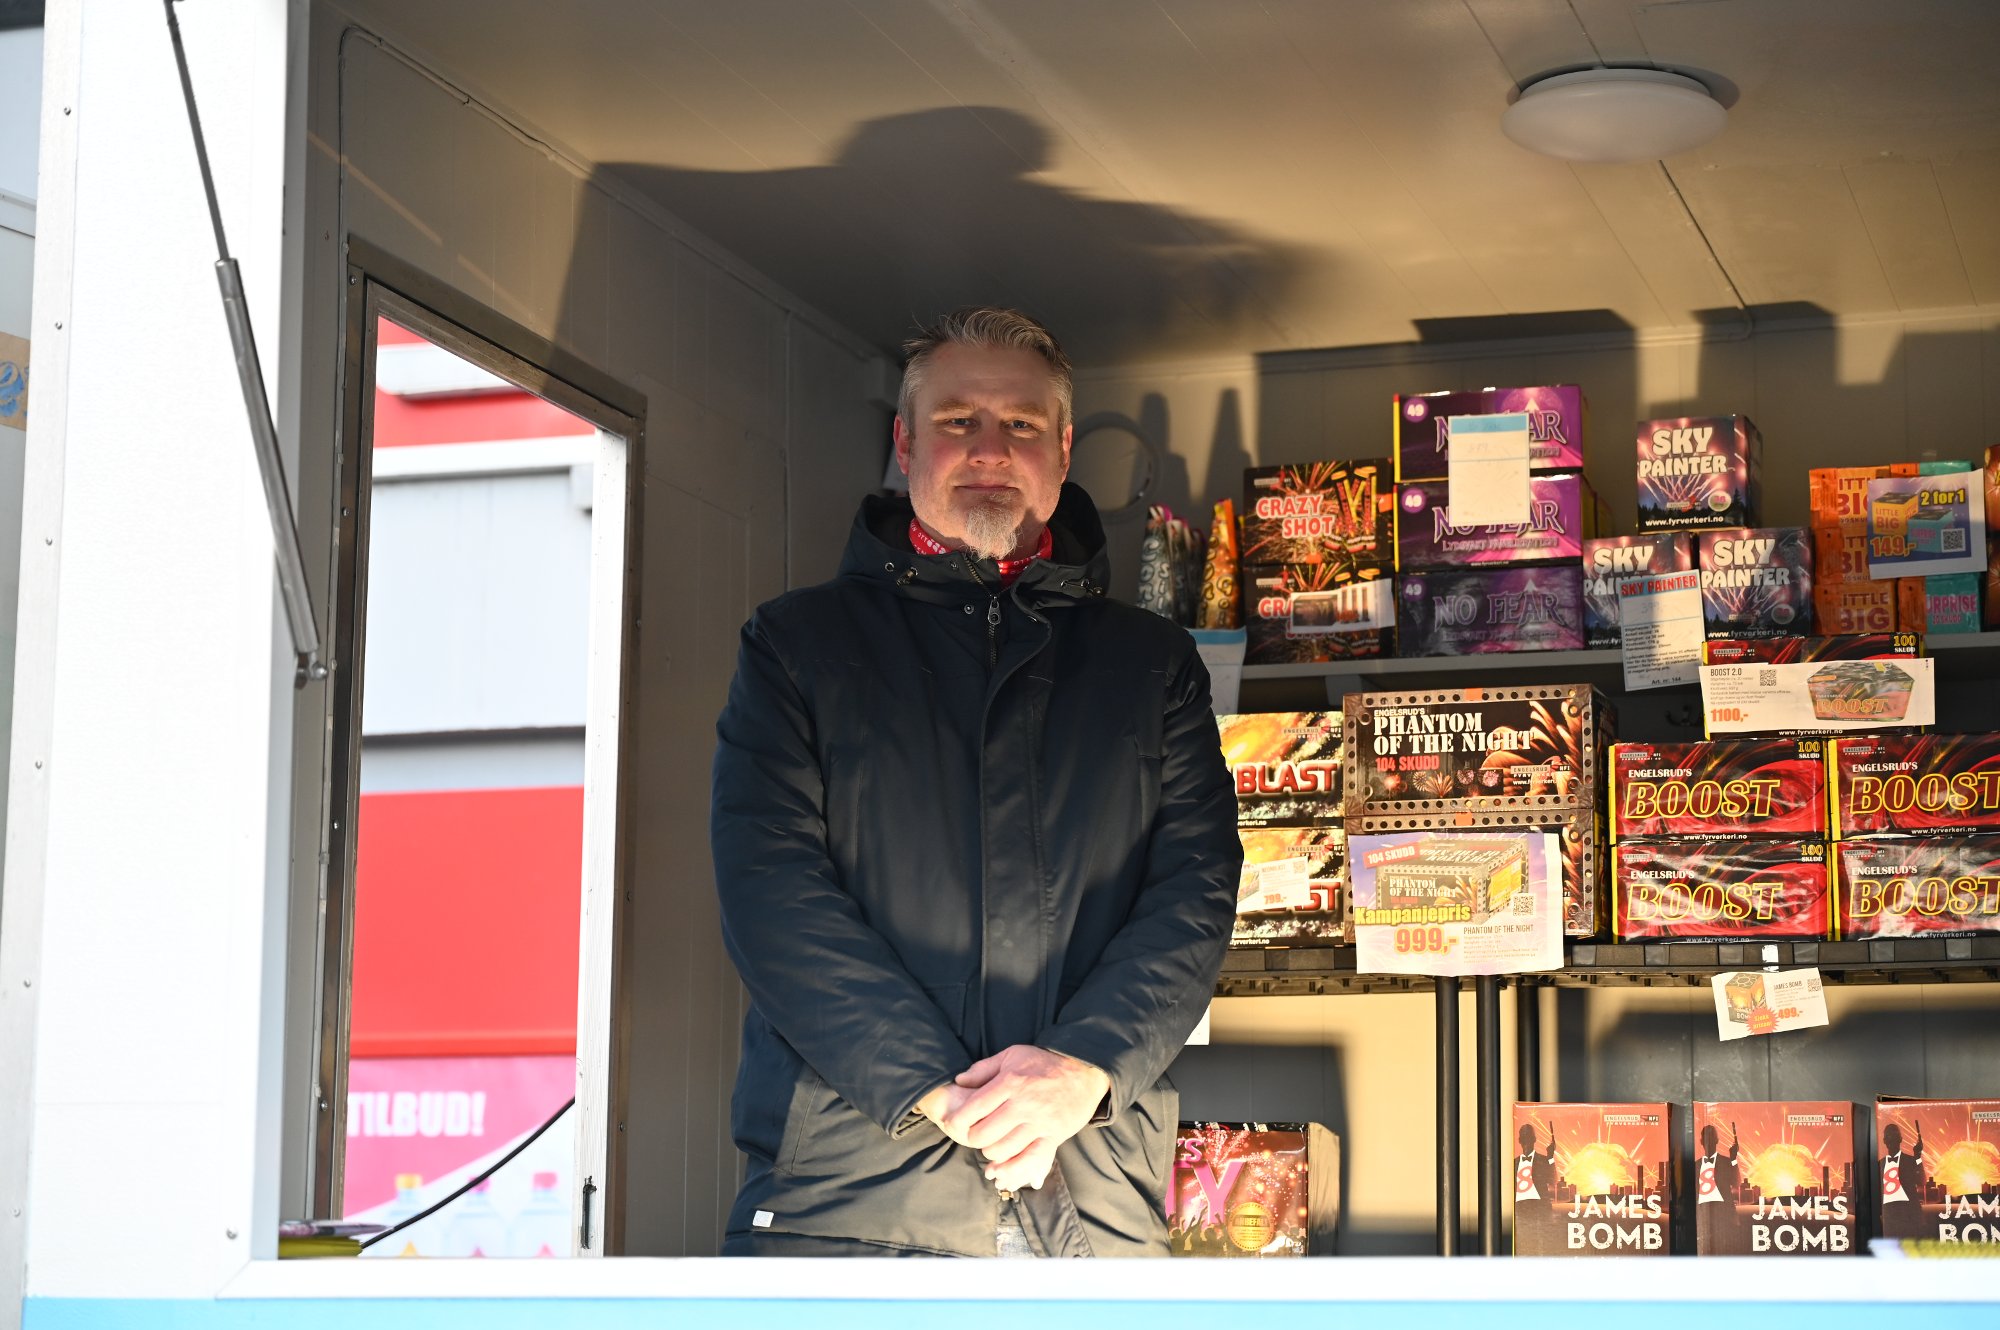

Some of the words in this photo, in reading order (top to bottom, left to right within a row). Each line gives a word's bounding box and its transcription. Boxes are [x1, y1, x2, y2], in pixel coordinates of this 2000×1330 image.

[1407, 404, 1424, 417] 49
[1652, 427, 1713, 456] SKY
[1639, 455, 1727, 478] PAINTER
[1256, 494, 1324, 519] CRAZY
[1405, 495, 1422, 508] 49
[1920, 492, 1929, 506] 2
[1933, 491, 1954, 504] for
[1957, 489, 1965, 503] 1
[1645, 515, 1724, 527] www.fyrverkeri.no
[1875, 507, 1899, 517] LITTLE
[1282, 515, 1336, 539] SHOT
[1876, 517, 1900, 530] BIG
[1713, 538, 1775, 567] SKY
[1871, 536, 1916, 557] 149,-
[1593, 545, 1654, 575] SKY
[1621, 581, 1645, 597] SKY
[1647, 575, 1697, 593] PAINTER
[1701, 567, 1791, 588] PAINTER
[1405, 583, 1422, 596] 49
[1258, 597, 1292, 619] CRA
[1842, 592, 1889, 607] ITTLE
[1432, 594, 1478, 632] NO
[1486, 590, 1568, 629] FEAR
[1708, 629, 1788, 639] www.fyrverkeri.no
[1893, 634, 1917, 647] 100
[1710, 668, 1730, 676] BOOST
[1731, 667, 1742, 676] 2.0
[1374, 707, 1426, 717] ENGELSRUD'S
[1711, 707, 1749, 722] 1100,-
[1815, 698, 1889, 713] BOOST
[1374, 712, 1483, 736] PHANTOM
[1374, 735, 1403, 756] OF
[1409, 733, 1455, 754] THE
[1462, 730, 1535, 752] NIGHT
[1798, 741, 1821, 753] 100
[1375, 757, 1396, 772] 104
[1399, 755, 1440, 771] SKUDD
[1852, 761, 1918, 773] ENGELSRUD'S
[1233, 760, 1341, 797] BLAST
[1628, 768, 1693, 778] ENGELSRUD'S
[1625, 779, 1781, 818] BOOST
[1850, 771, 2000, 814] BOOST
[1684, 833, 1747, 841] www.fyrverkeri.no
[1911, 827, 1977, 835] www.fyrverkeri.no
[1368, 854, 1384, 865] 104
[1385, 846, 1416, 861] SKUDD
[1801, 844, 1823, 856] 100
[1630, 870, 1695, 879] ENGELSRUD'S
[1851, 865, 1918, 876] ENGELSRUD'S
[1389, 879, 1437, 889] PHANTOM
[1389, 888, 1402, 897] OF
[1404, 888, 1424, 897] THE
[1427, 887, 1457, 897] NIGHT
[1627, 882, 1784, 921] BOOST
[1849, 875, 2000, 917] BOOST
[1354, 904, 1472, 926] Kampanjepris
[1463, 926, 1493, 935] PHANTOM
[1494, 925, 1502, 933] OF
[1503, 925, 1514, 933] THE
[1515, 923, 1534, 932] NIGHT
[1395, 927, 1459, 953] 999,-
[1686, 936, 1750, 944] www.fyrverkeri.no
[1773, 982, 1789, 991] JAMES
[1789, 980, 1803, 989] BOMB
[348, 1091, 486, 1138] TILBUD!
[1567, 1193, 1662, 1219] JAMES
[1752, 1195, 1848, 1221] JAMES
[1938, 1194, 2000, 1220] JAM
[1567, 1222, 1663, 1250] BOMB
[1751, 1224, 1850, 1252] BOMB
[1938, 1223, 2000, 1245] BO
